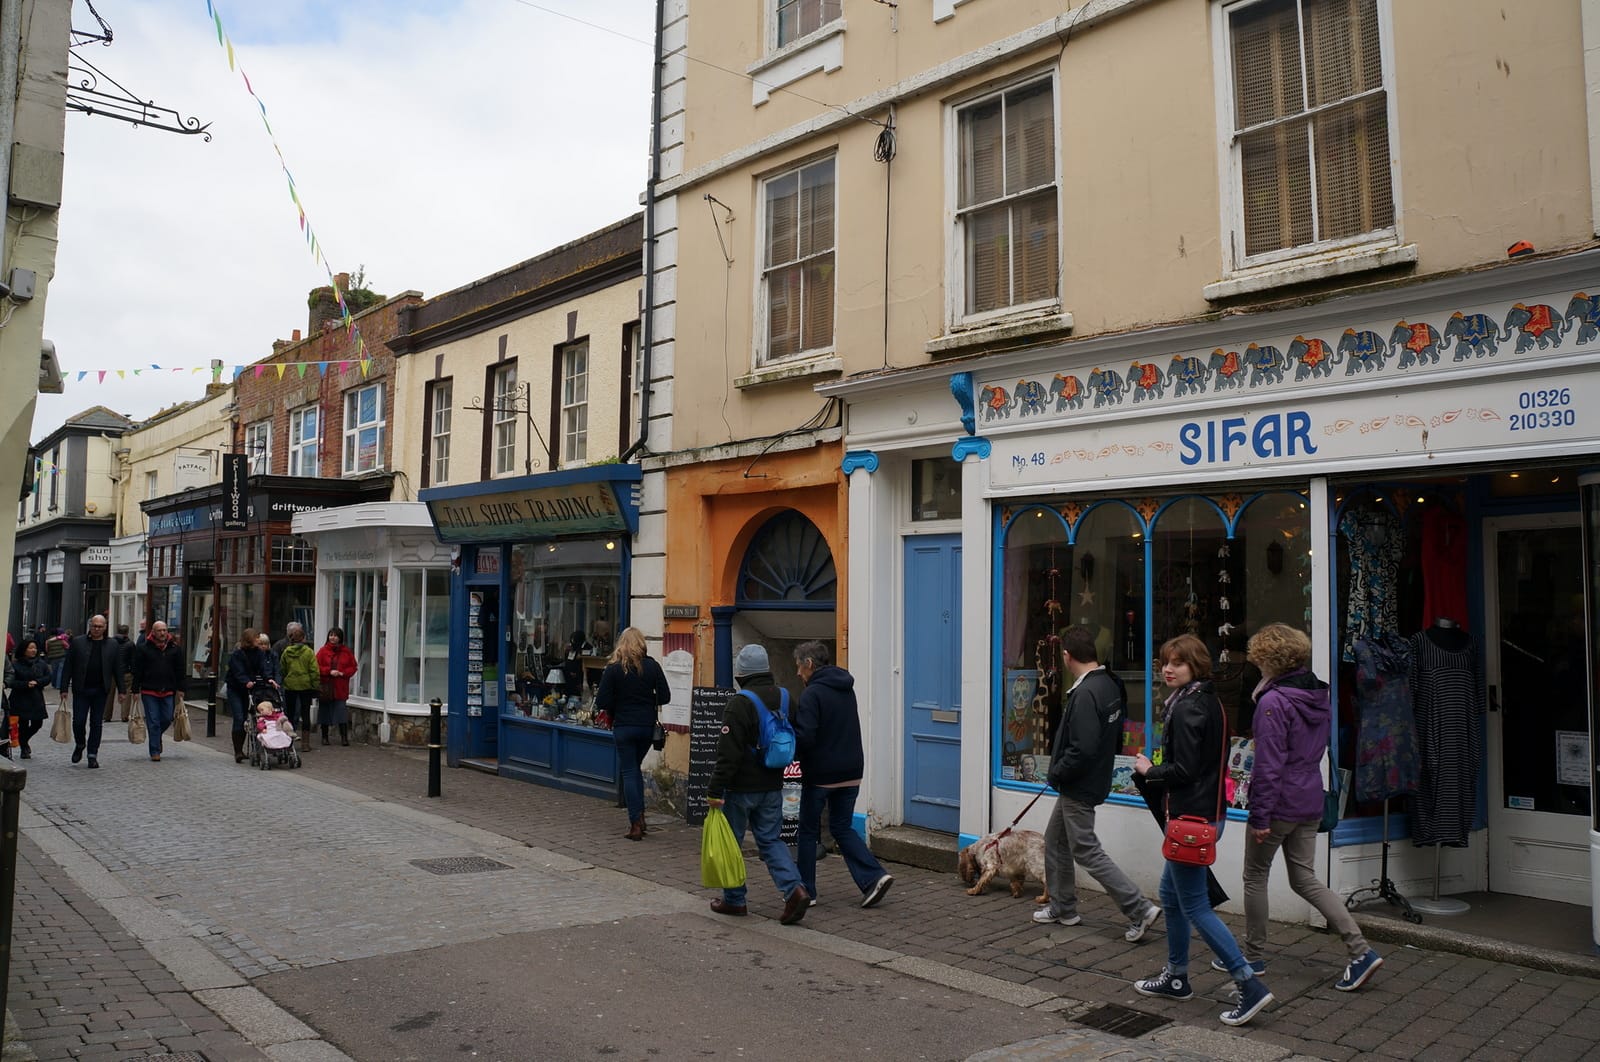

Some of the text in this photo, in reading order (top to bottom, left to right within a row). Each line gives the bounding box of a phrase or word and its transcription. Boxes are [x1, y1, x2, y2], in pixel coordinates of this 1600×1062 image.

[1519, 388, 1570, 409] 01326
[1509, 409, 1575, 431] 210330
[1179, 411, 1318, 465] SIFAR
[1031, 452, 1045, 466] 48
[230, 458, 241, 519] driftwood
[443, 495, 600, 528] TALL SHIPS TRADING
[224, 519, 246, 527] gallery
